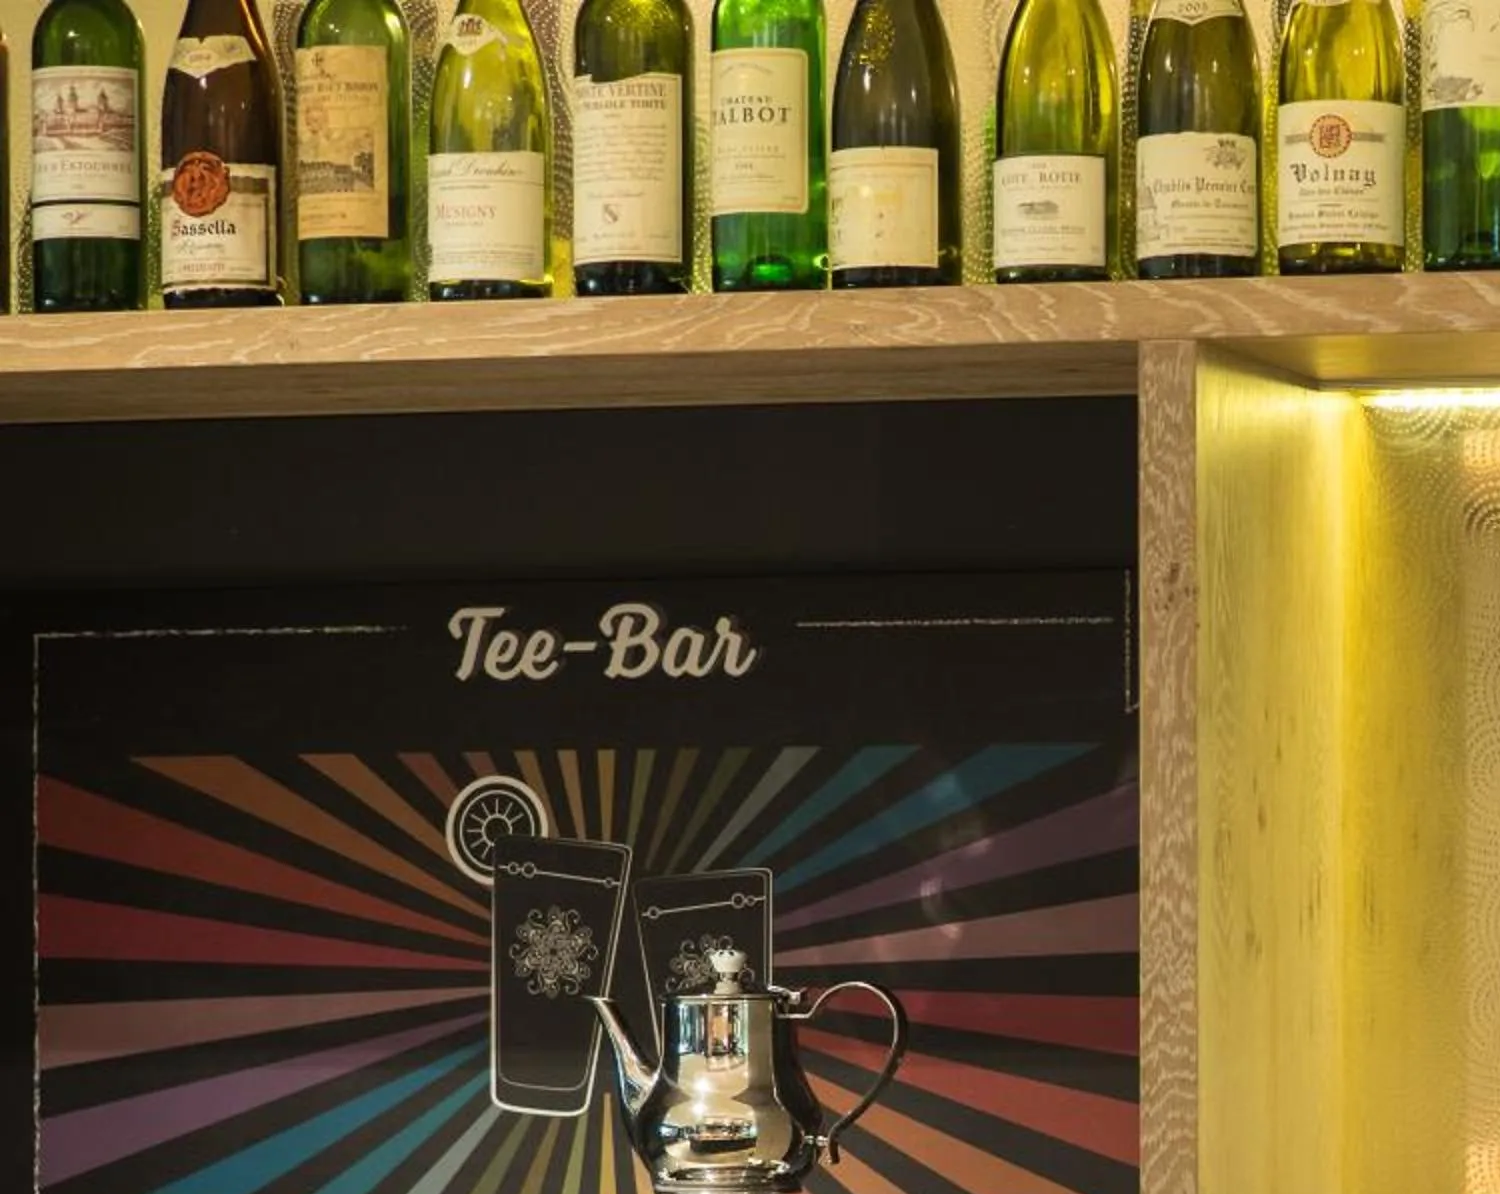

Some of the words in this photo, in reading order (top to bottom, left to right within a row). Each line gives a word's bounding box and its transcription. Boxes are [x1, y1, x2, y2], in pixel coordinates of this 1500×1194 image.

[713, 106, 792, 127] TALBOT
[1289, 163, 1377, 188] Volnay
[171, 218, 237, 240] Sassella
[447, 603, 757, 682] Tee-Bar
